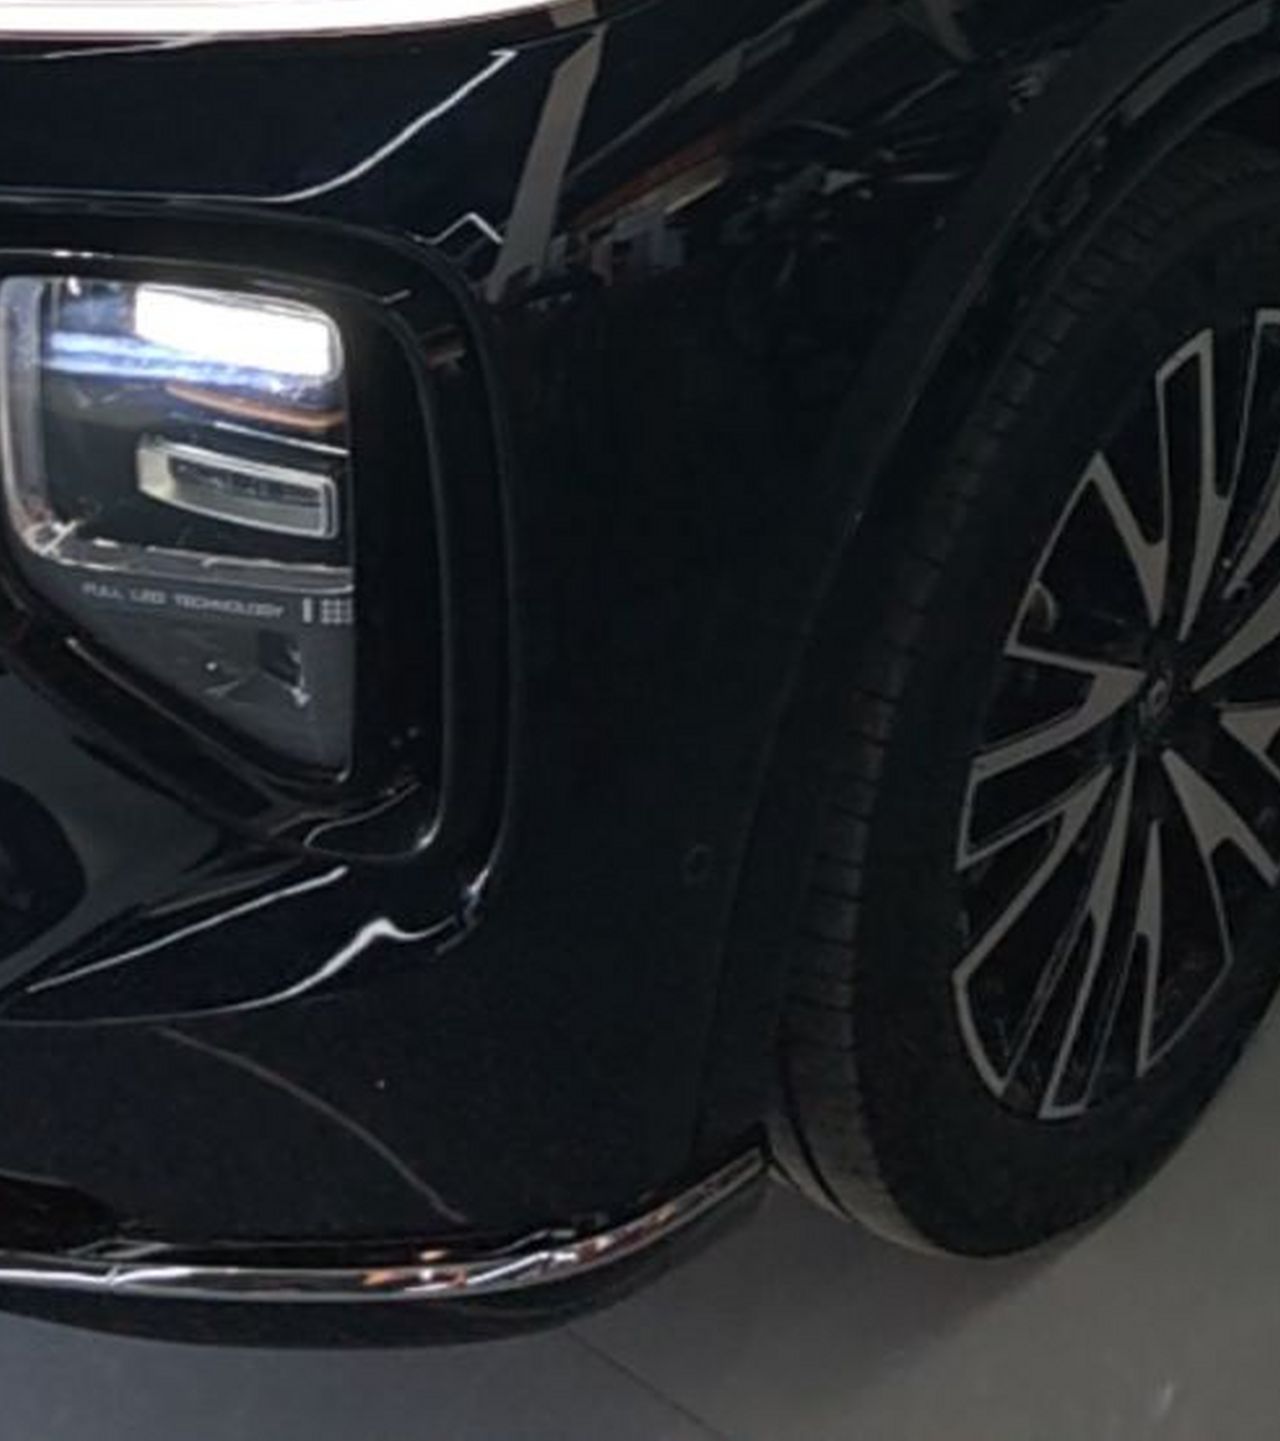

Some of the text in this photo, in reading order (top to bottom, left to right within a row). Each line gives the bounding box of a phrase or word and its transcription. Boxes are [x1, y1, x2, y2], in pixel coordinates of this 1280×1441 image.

[81, 581, 285, 618] FULL LED TECHNOLOGY
